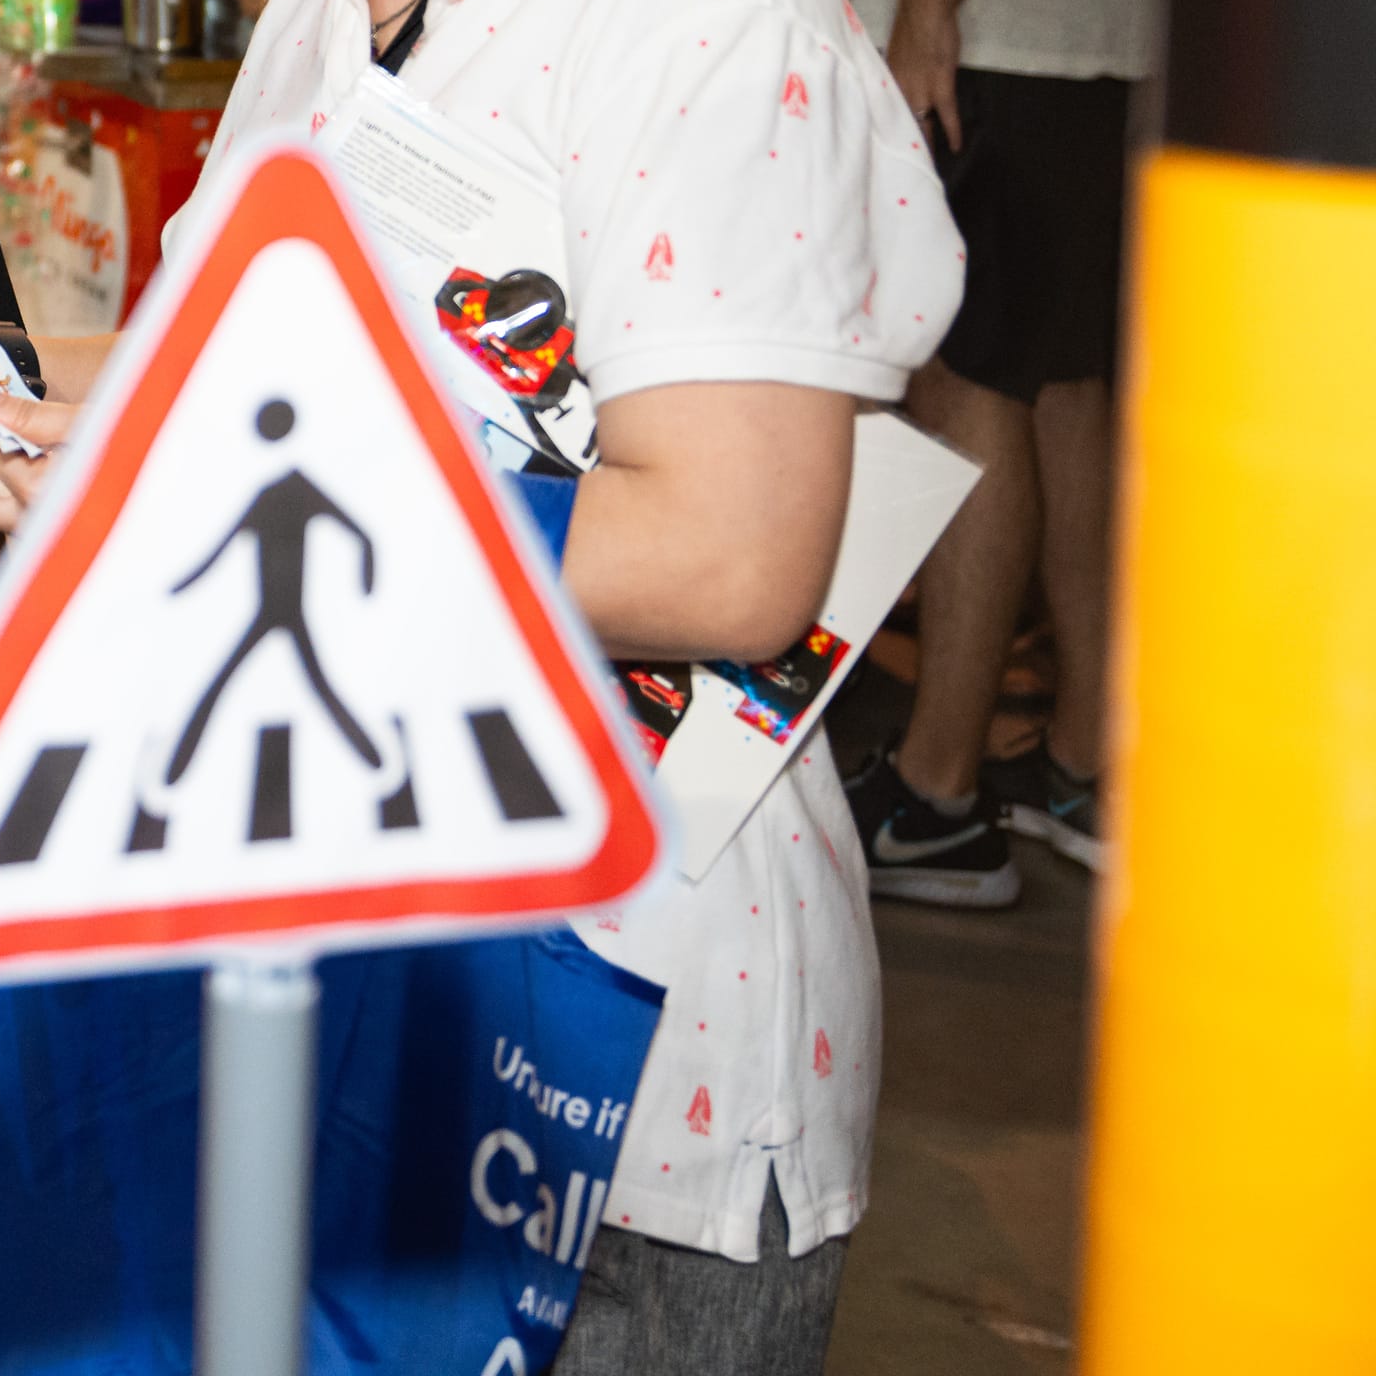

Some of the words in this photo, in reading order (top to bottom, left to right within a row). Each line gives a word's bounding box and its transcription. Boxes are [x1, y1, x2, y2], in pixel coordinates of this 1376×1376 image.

[493, 1036, 591, 1129] Unure
[593, 1097, 627, 1141] if
[469, 1127, 608, 1271] Call
